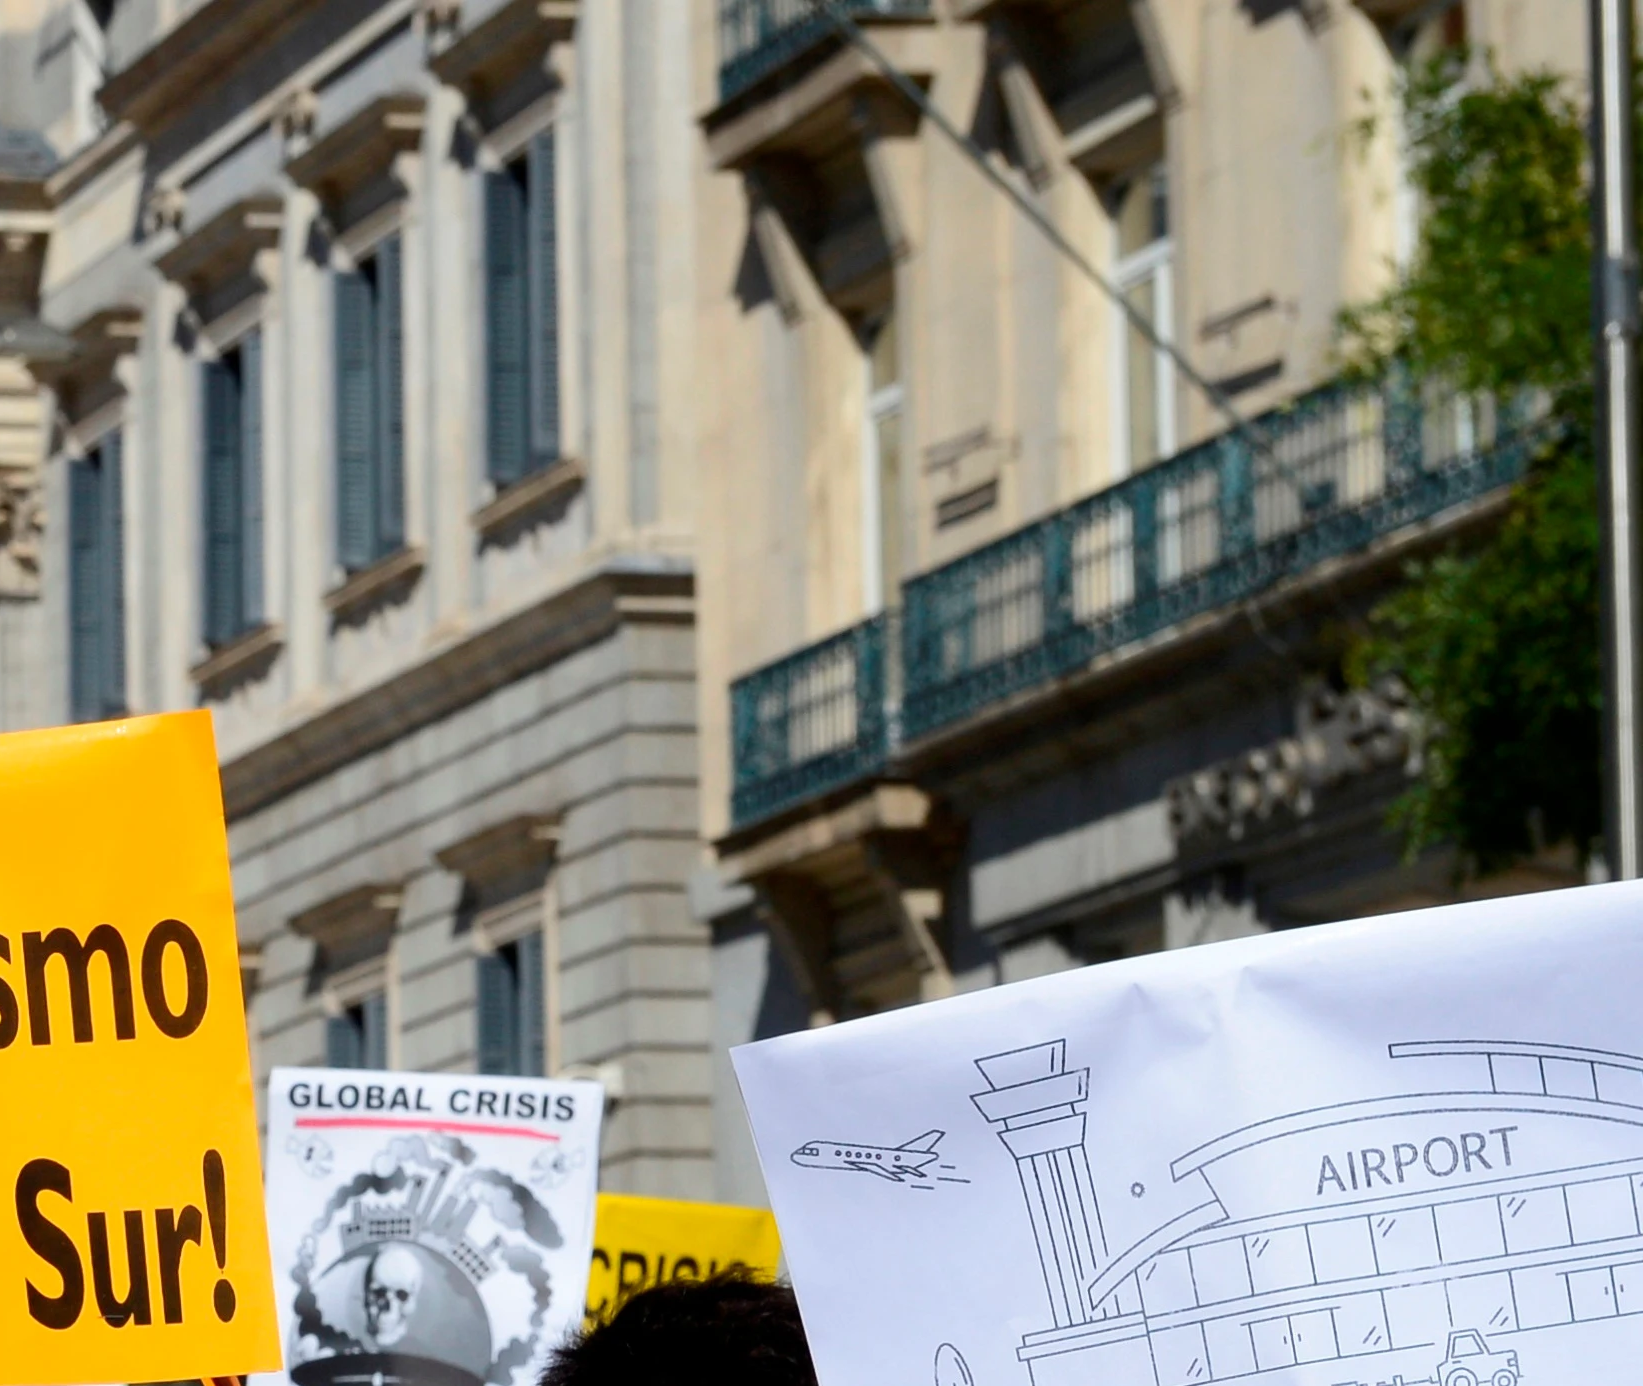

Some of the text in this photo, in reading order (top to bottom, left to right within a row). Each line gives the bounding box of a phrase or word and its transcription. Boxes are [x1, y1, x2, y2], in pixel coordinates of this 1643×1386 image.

[288, 1083, 575, 1121] GLOBAL CRISIS
[1316, 1126, 1518, 1196] AIRPORT
[15, 1149, 236, 1331] Sur!
